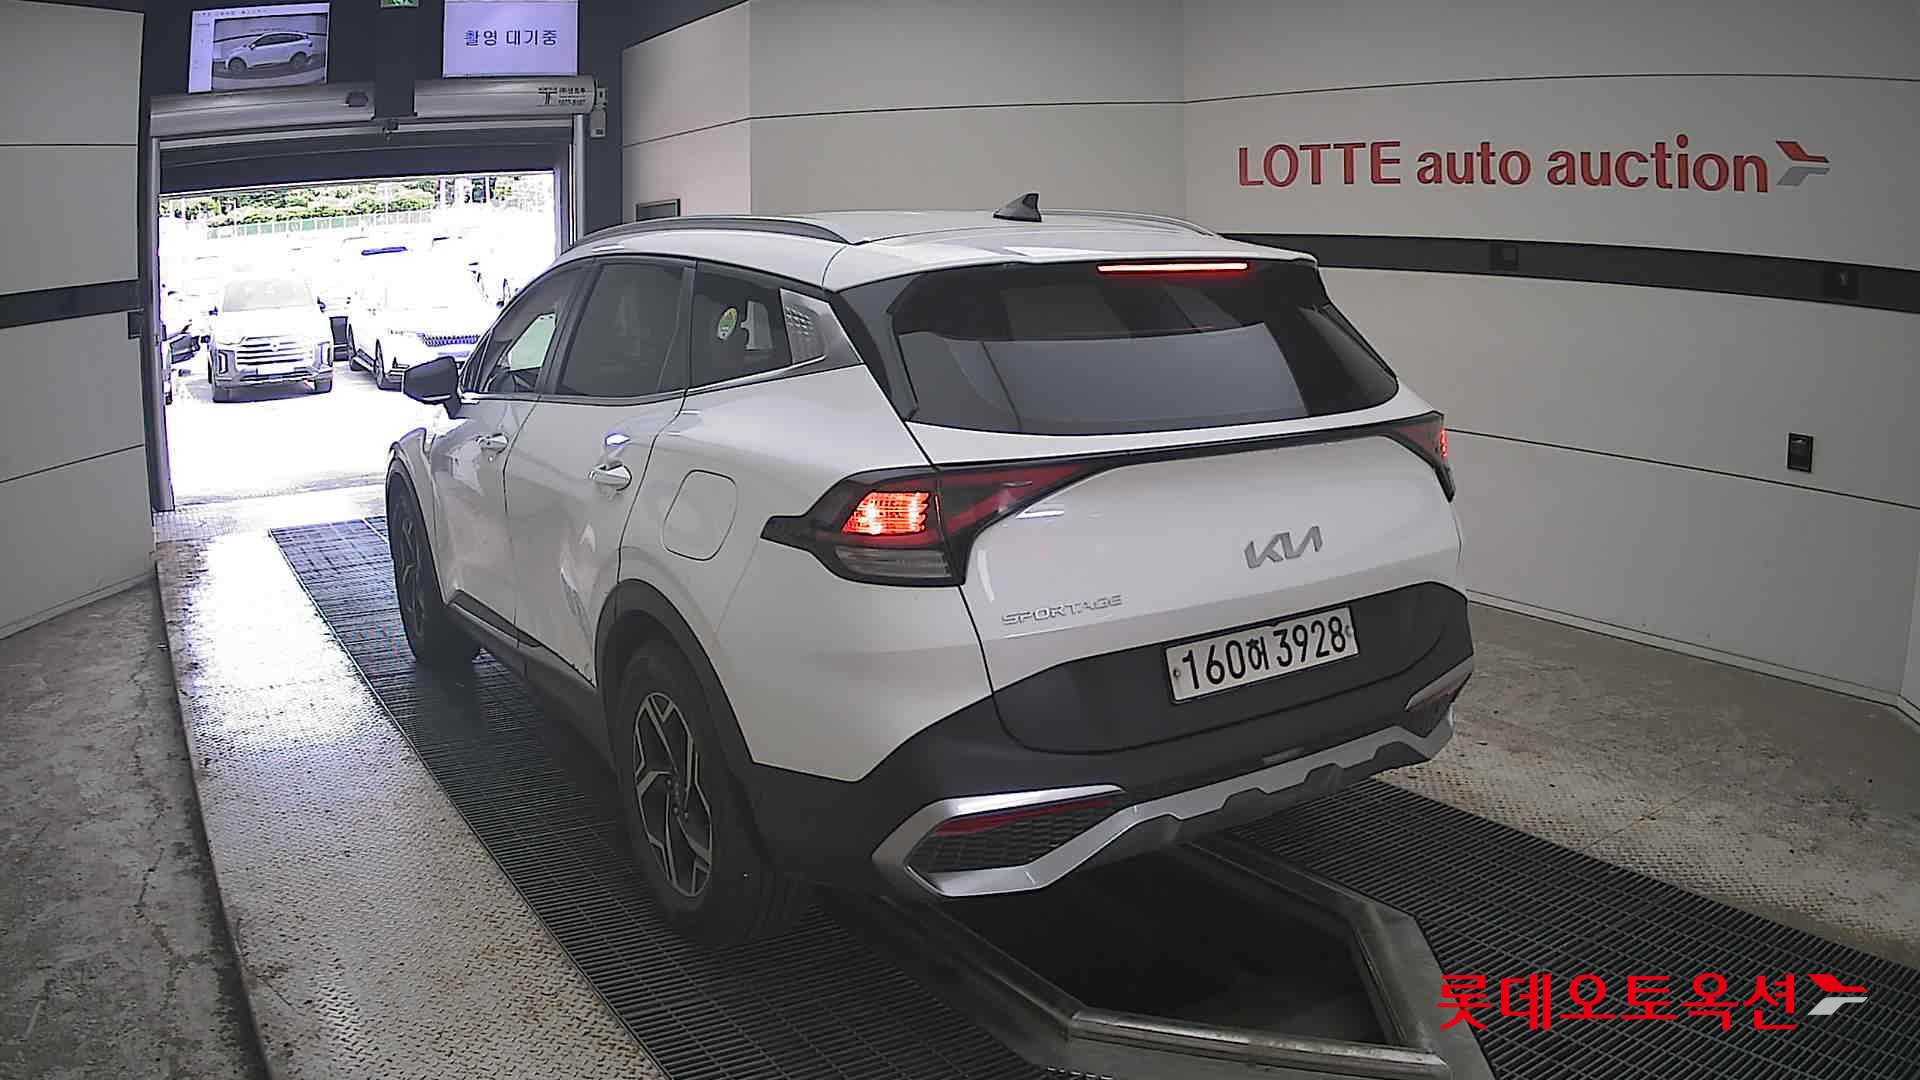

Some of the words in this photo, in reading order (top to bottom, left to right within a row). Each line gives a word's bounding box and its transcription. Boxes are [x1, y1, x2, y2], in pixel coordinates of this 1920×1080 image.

[505, 29, 558, 46] 대기중
[1238, 141, 1402, 187] LOTTE
[1416, 142, 1532, 185] auto
[1546, 134, 1769, 193] auction
[1244, 525, 1323, 569] KIA
[1001, 594, 1122, 626] SPORTAGE
